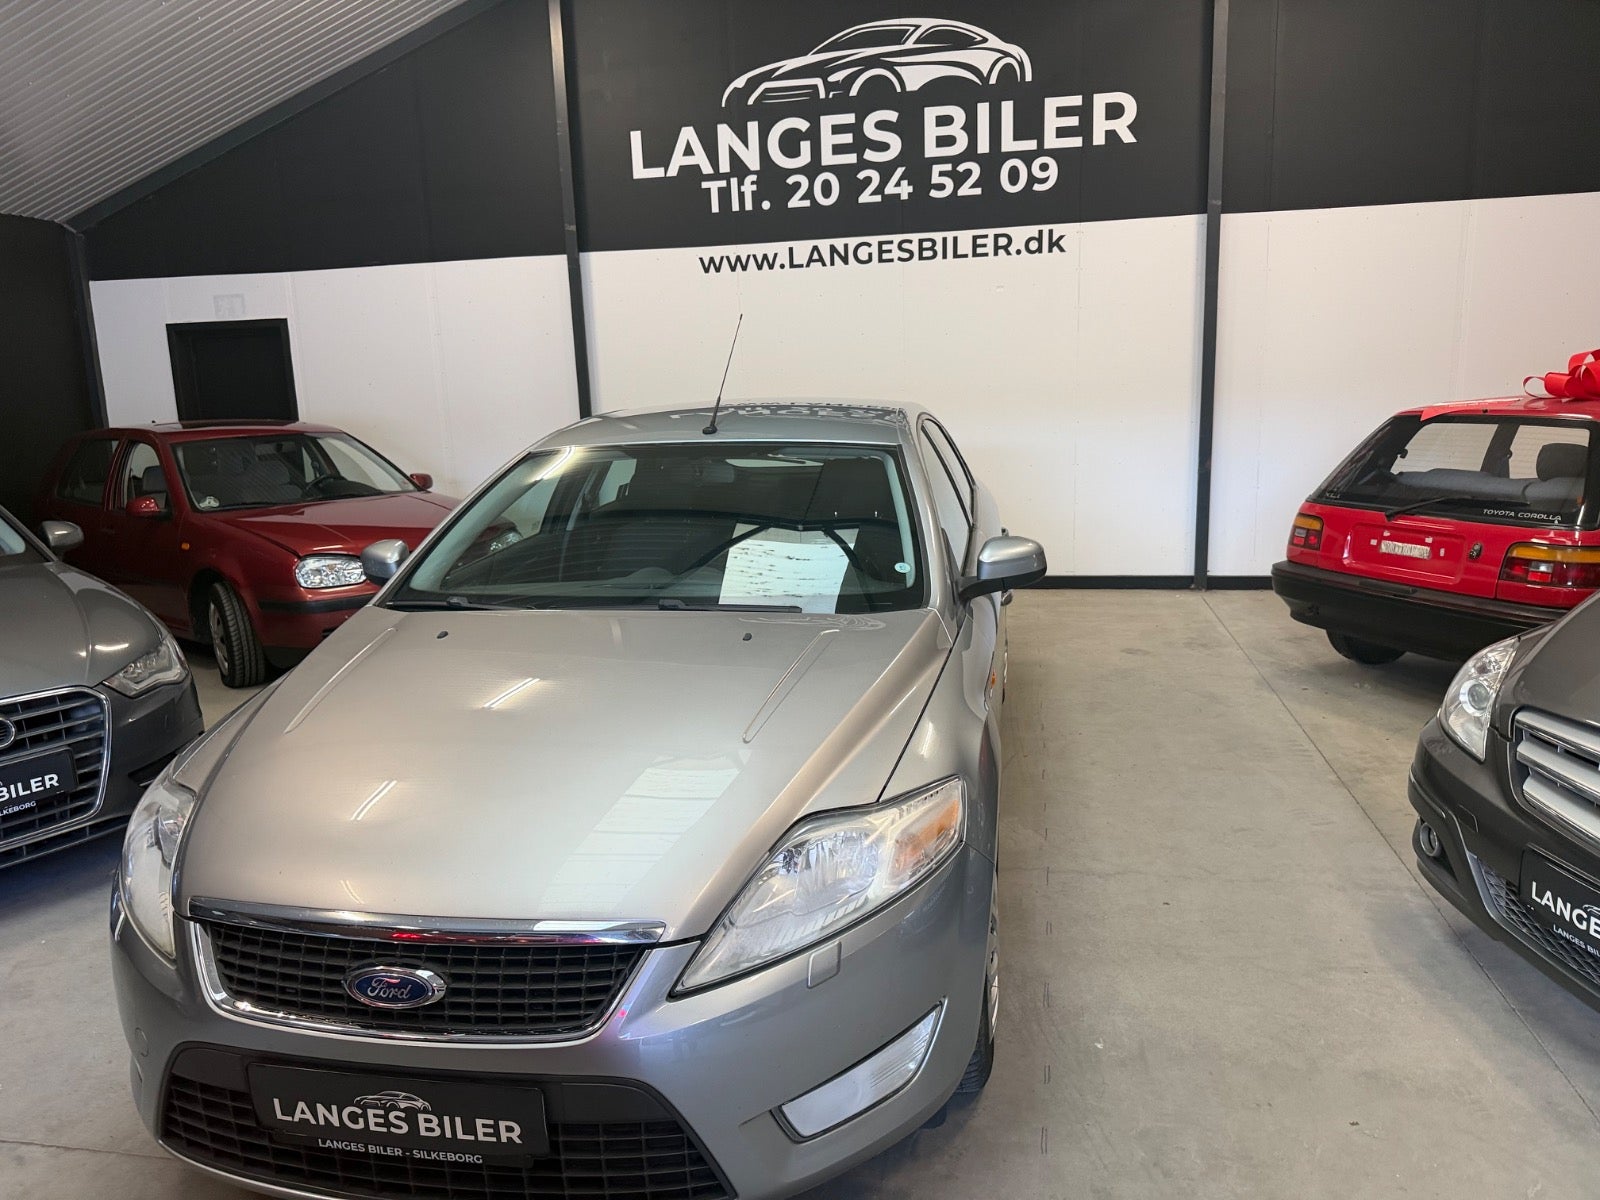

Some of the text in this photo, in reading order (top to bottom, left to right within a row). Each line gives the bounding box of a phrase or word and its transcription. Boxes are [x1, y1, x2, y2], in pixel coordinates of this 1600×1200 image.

[629, 91, 1138, 180] LANGES BILER
[701, 156, 1059, 214] Tlf. 20 24 52 09
[699, 229, 1066, 274] www.LANGESBILER.dk
[1483, 508, 1562, 521] TOYOTA COROLLA
[0, 773, 60, 802] BILER
[1531, 880, 1600, 940] LANGE
[1553, 923, 1586, 949] LANGES
[367, 976, 412, 999] Ford
[272, 1097, 523, 1144] LANGES BILER
[318, 1138, 366, 1153] LANGES
[368, 1143, 403, 1157] BILER
[412, 1149, 483, 1165] SILKEBORG
